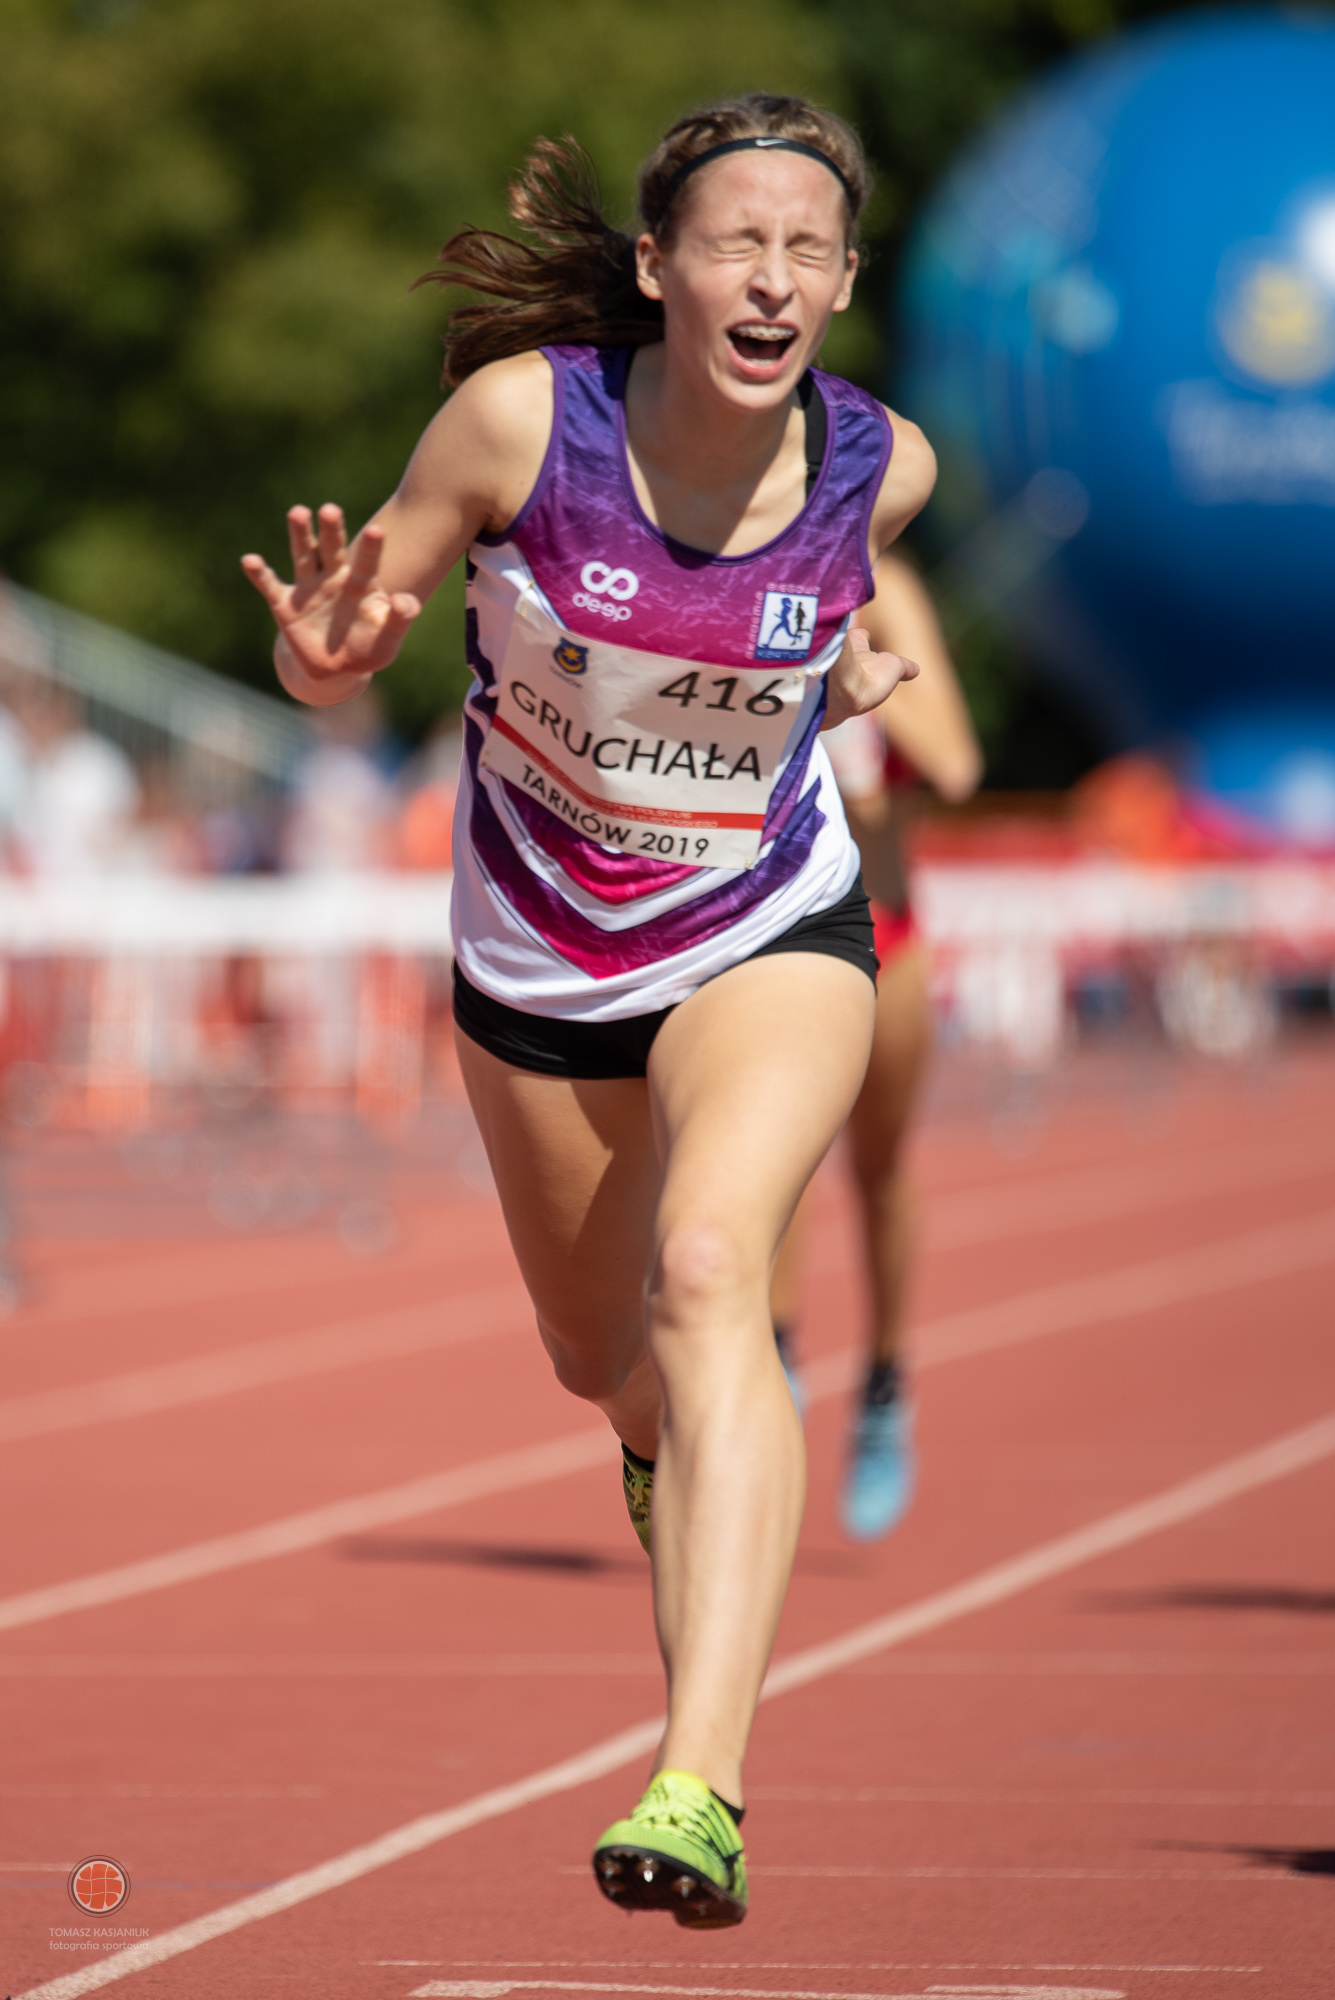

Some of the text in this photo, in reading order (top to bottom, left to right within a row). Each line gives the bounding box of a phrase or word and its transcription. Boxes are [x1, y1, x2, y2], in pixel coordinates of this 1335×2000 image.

[572, 591, 633, 622] deep
[658, 671, 785, 717] 416
[510, 680, 762, 782] GRUCHAŁA
[523, 764, 632, 845] TARNÓW
[638, 832, 709, 858] 2019
